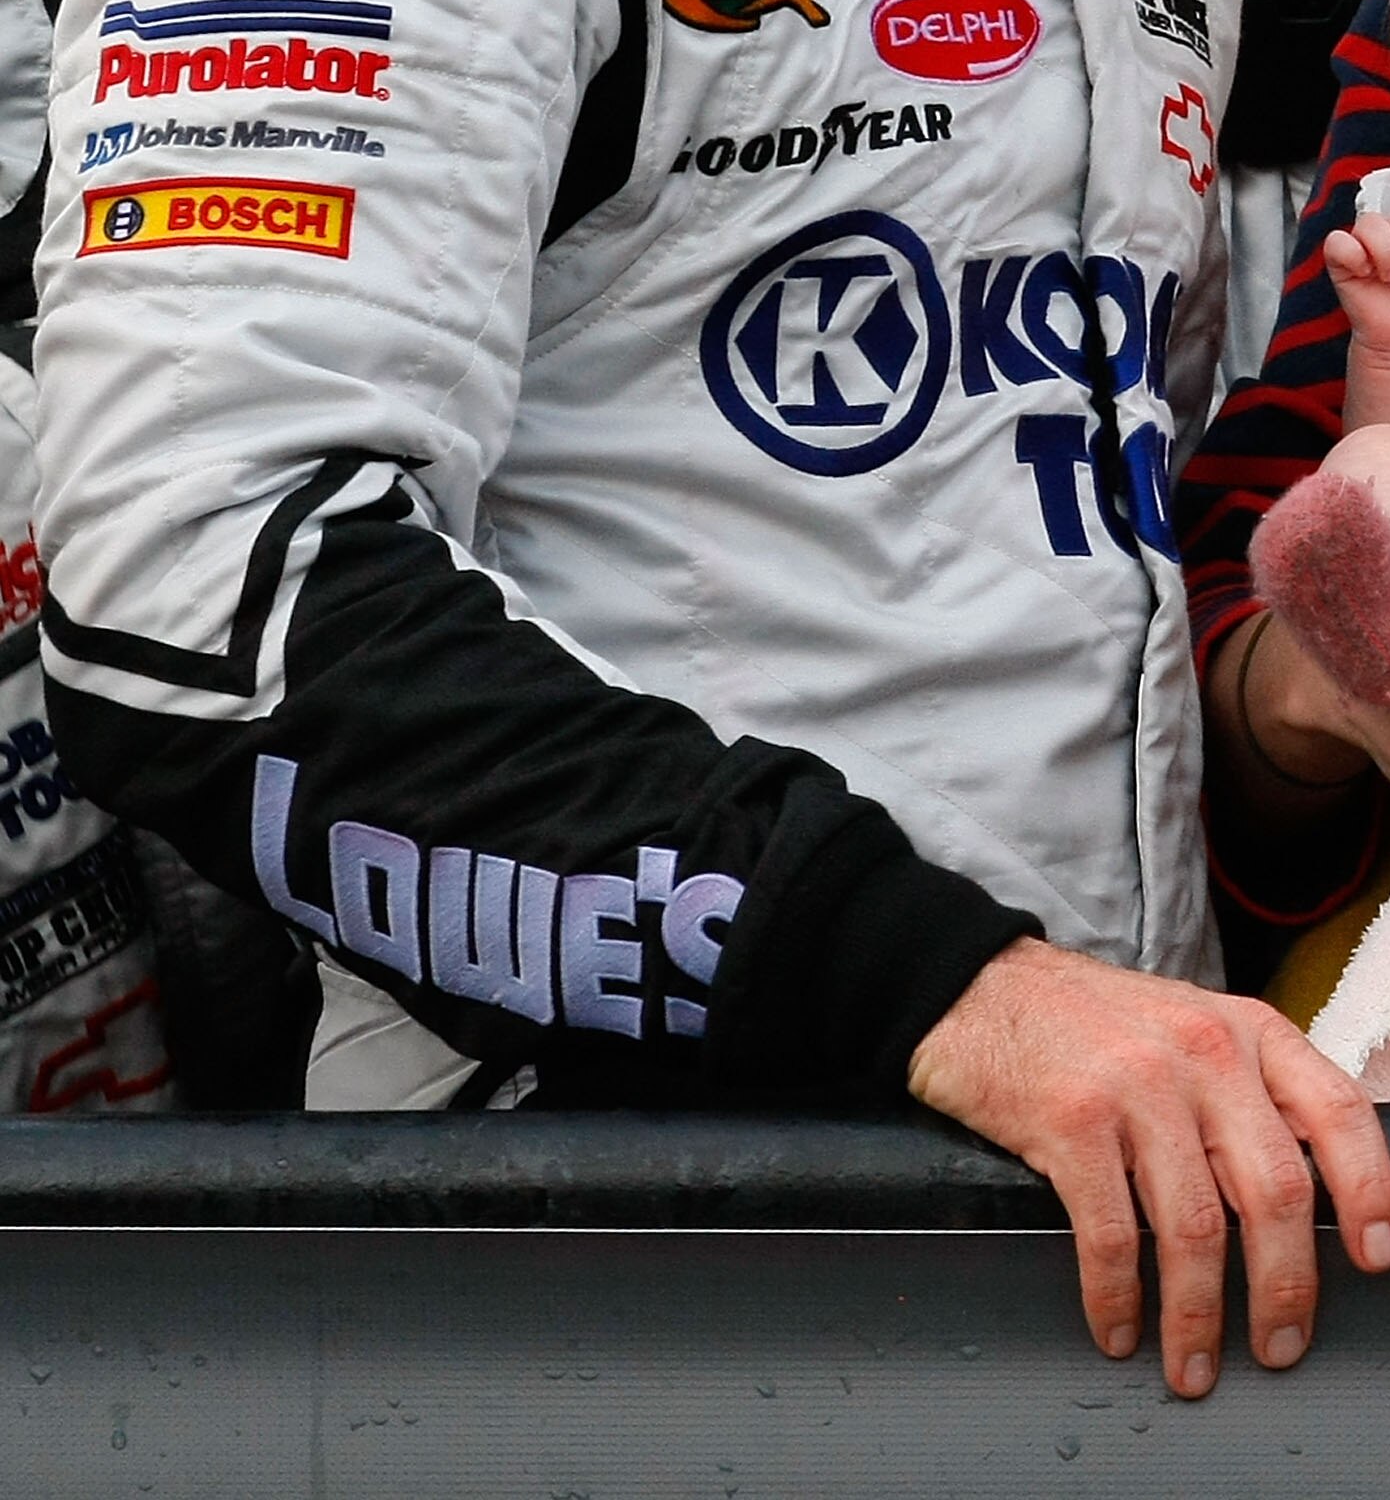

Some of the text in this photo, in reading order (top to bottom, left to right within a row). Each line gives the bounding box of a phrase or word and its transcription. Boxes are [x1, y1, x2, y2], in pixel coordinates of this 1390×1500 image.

[888, 9, 1024, 46] DELPHI
[93, 38, 390, 106] Purolator
[134, 119, 227, 150] Johns
[230, 121, 385, 157] Manville
[167, 194, 329, 238] BOSCH
[251, 754, 747, 1040] LOWE'S
